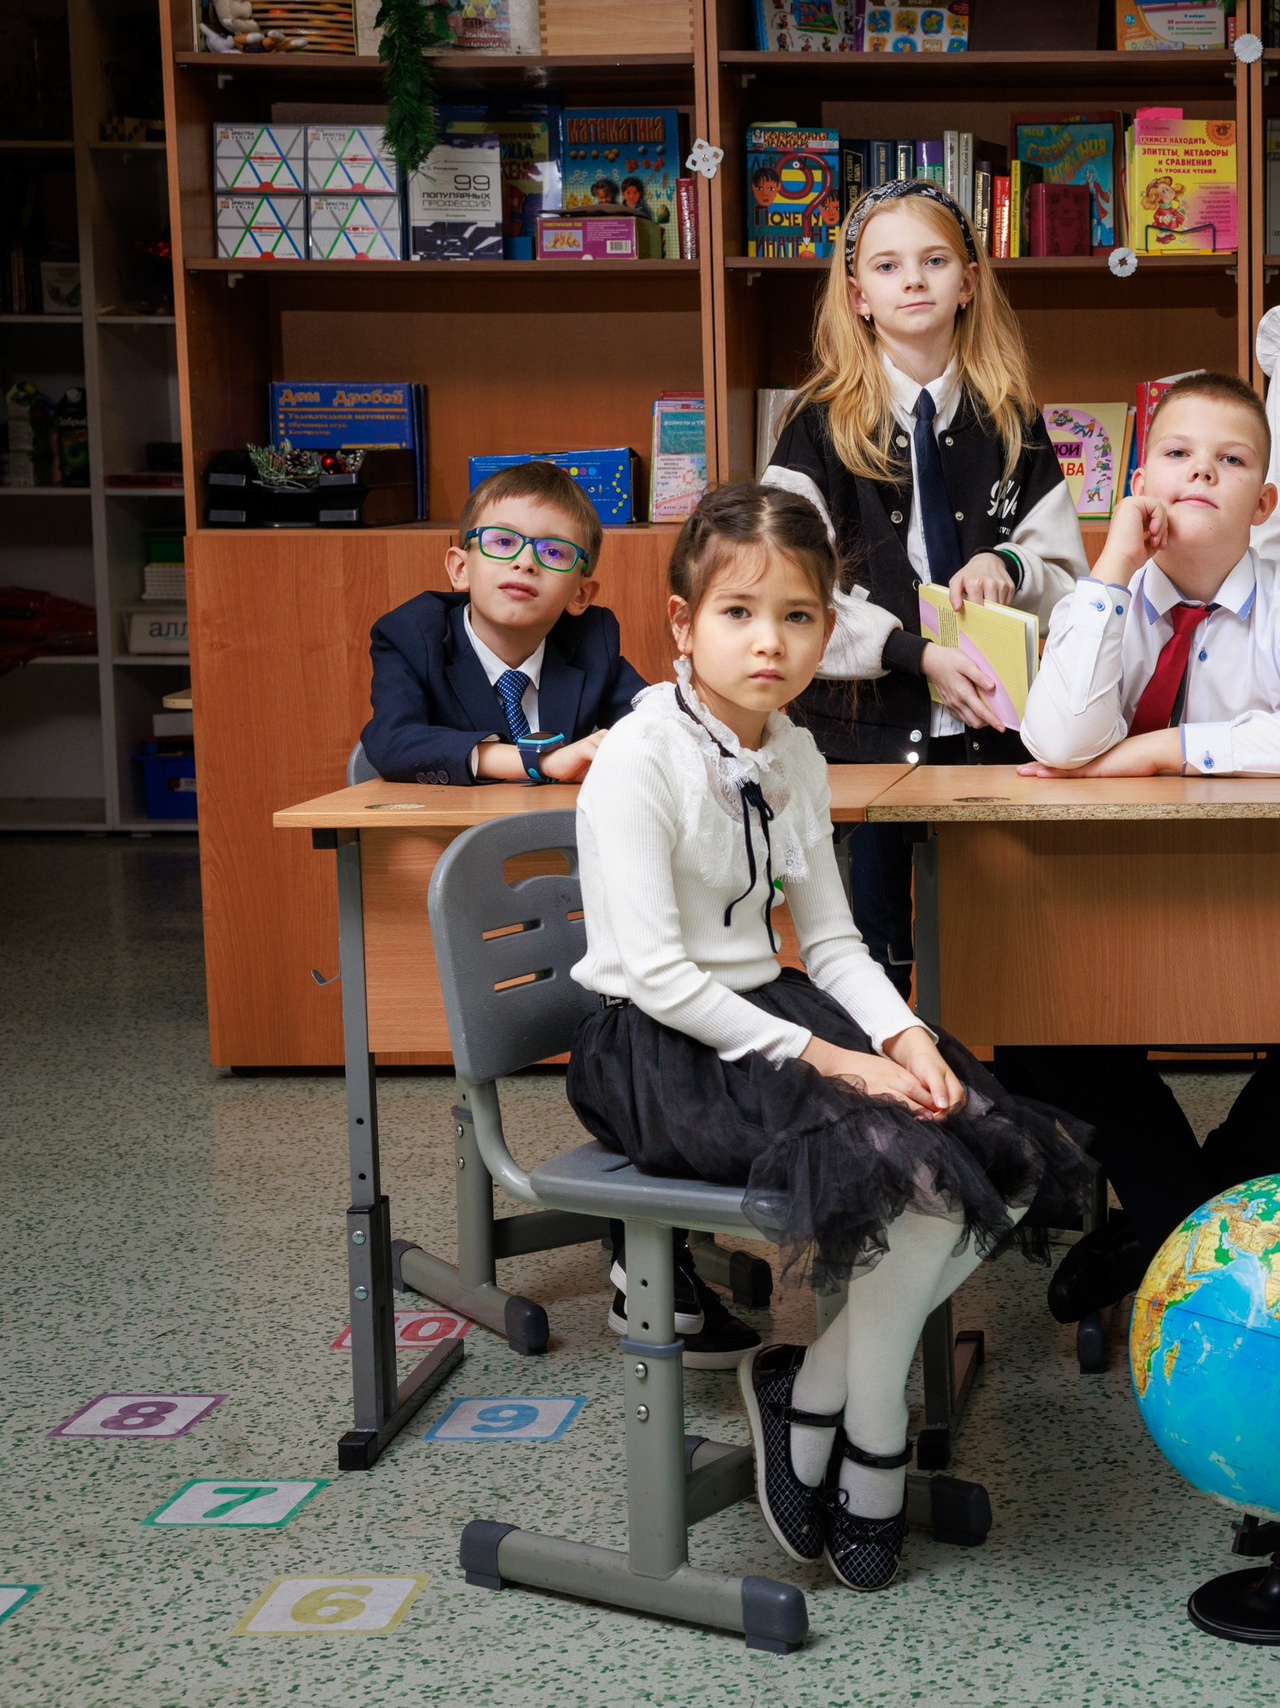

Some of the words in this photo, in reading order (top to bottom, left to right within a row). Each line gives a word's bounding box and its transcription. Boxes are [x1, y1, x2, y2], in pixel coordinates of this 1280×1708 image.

[1169, 137, 1206, 145] НАХОДИТЬ
[1142, 148, 1180, 157] ЭПИТЕТЫ,
[1184, 149, 1228, 157] МЕТАФОРЫ
[1165, 158, 1212, 166] СРАВНЕНИЯ
[454, 174, 490, 191] 99
[422, 200, 491, 208] ПРОФЕССИЙ
[279, 389, 320, 406] Дом
[332, 388, 403, 407] Дробей
[1060, 462, 1084, 476] АВА
[394, 1316, 458, 1342] 0
[100, 1401, 179, 1430] 8
[470, 1403, 540, 1433] 9
[202, 1486, 280, 1519] 7
[290, 1585, 376, 1625] 6
